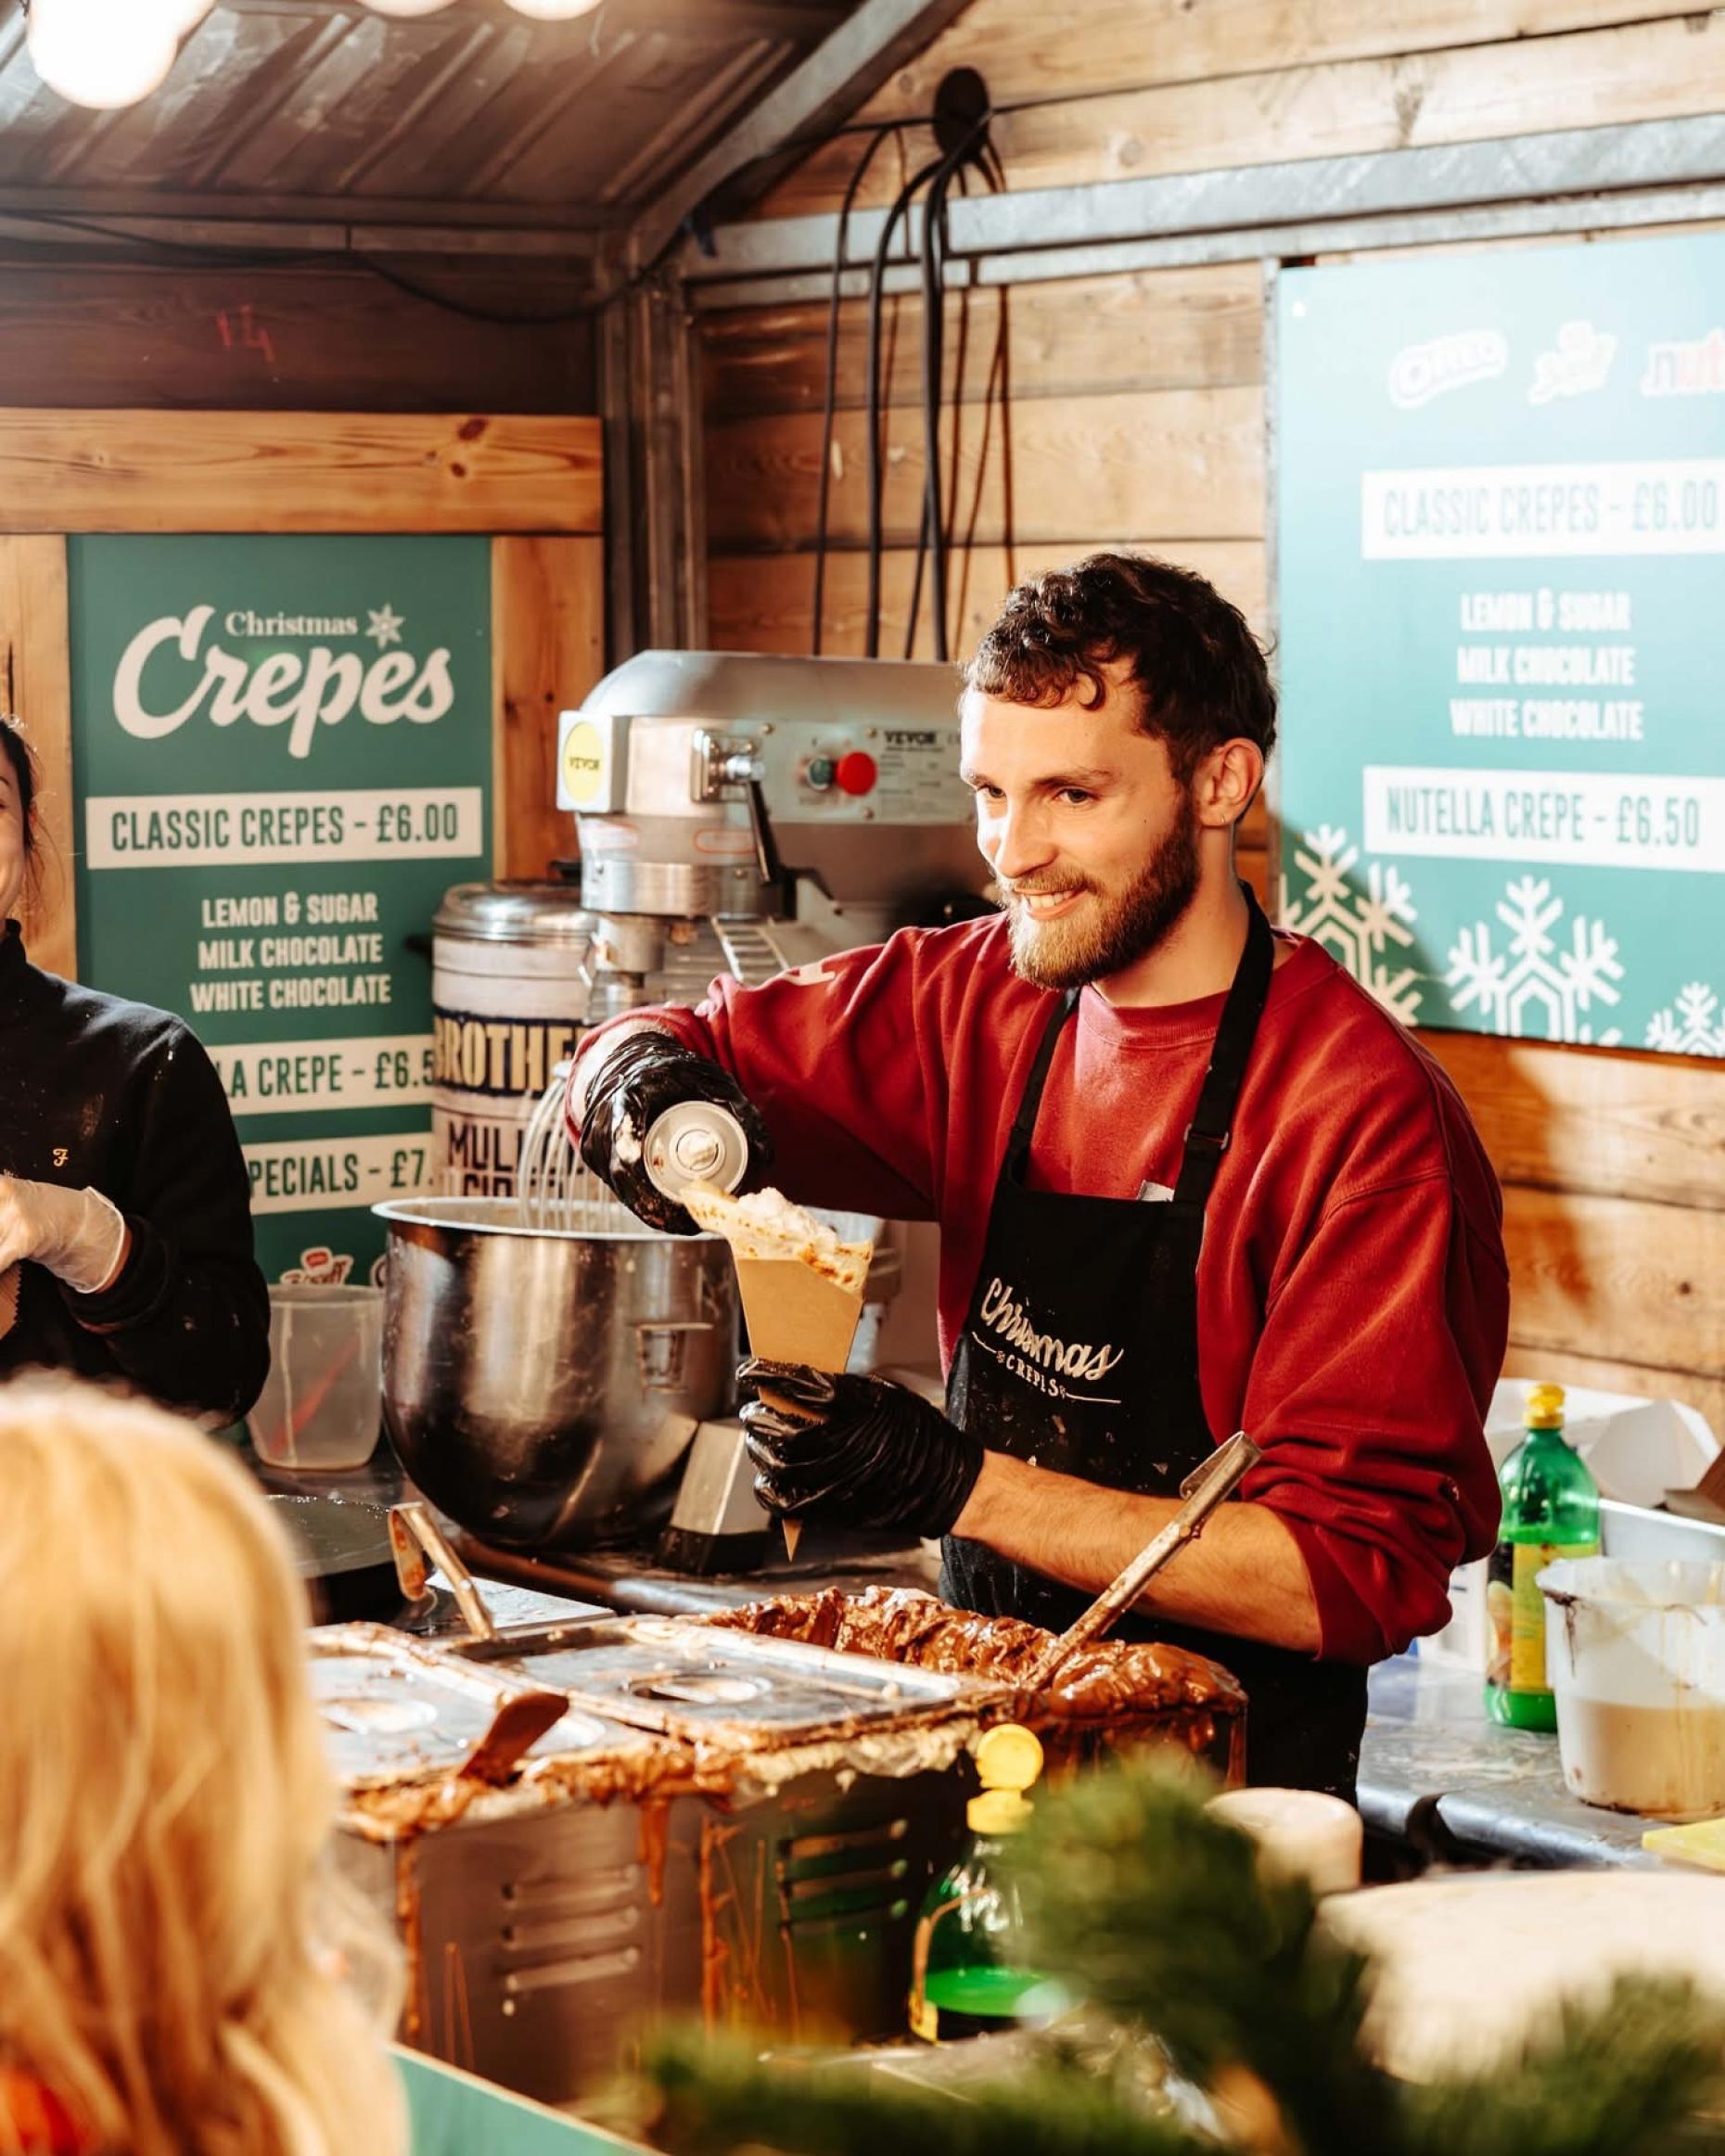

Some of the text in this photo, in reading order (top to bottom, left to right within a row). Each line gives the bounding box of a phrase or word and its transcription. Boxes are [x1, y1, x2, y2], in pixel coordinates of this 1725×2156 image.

[1385, 489, 1489, 537] CLASSIC
[1501, 483, 1600, 534] CREPES
[1632, 478, 1717, 530] £6.00
[225, 610, 359, 637] Christmas
[1461, 593, 1532, 631] LEMON
[1559, 592, 1630, 631] SUGAR
[113, 604, 454, 759] Crepes
[1457, 645, 1636, 685] MILK CHOCOLATE
[1450, 700, 1644, 740] WHITE CHOCOLATE
[111, 808, 229, 851] CLASSIC
[241, 805, 344, 847] CREPES
[376, 802, 458, 843] £6.00
[1386, 785, 1494, 837] NUTELLA
[1504, 790, 1584, 841] CREPE
[1616, 795, 1701, 848] £6.50
[201, 891, 378, 928] LEMON & SUGAR
[198, 933, 383, 970] MILK CHOCOLATE
[189, 975, 391, 1013] WHITE CHOCOLATE
[258, 1054, 343, 1098] CREPE
[375, 1049, 435, 1090] £6.5
[433, 1016, 582, 1091] BROTHE
[249, 1153, 359, 1198] PECIALS
